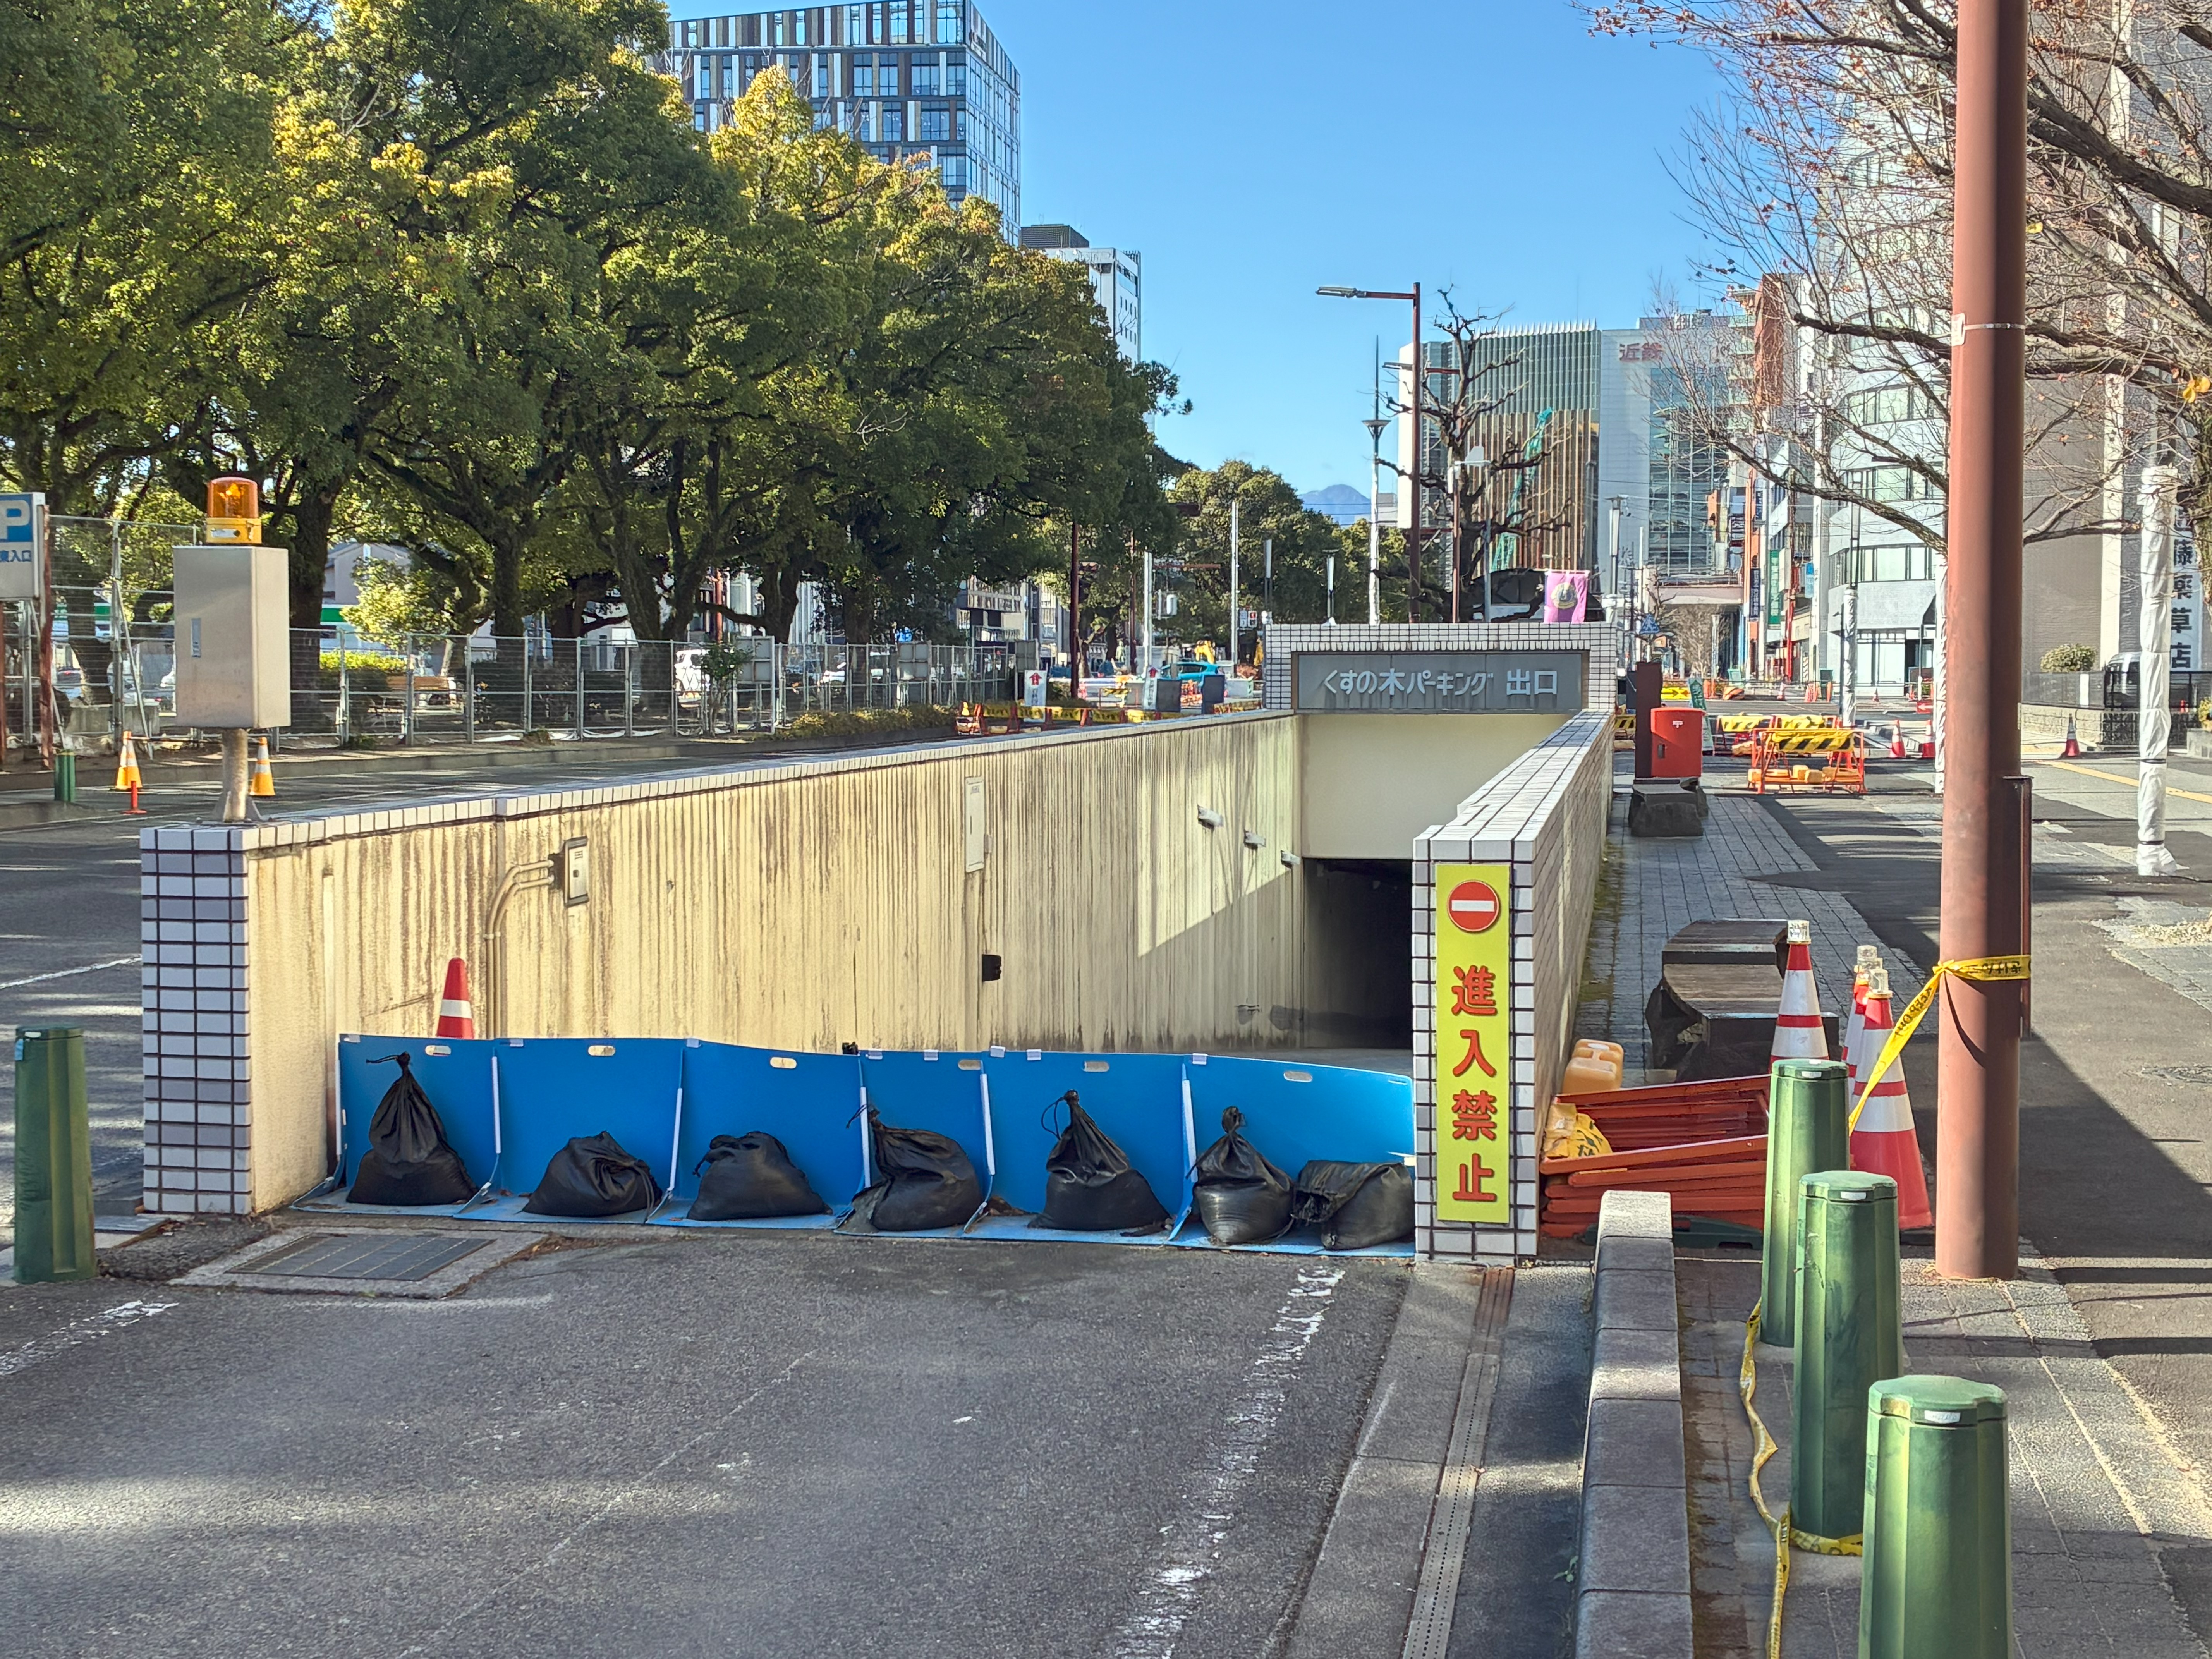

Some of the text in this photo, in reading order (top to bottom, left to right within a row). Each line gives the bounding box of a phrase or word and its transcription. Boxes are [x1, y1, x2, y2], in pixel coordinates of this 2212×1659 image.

[0, 500, 30, 539] P
[1324, 668, 1558, 696] くすの木パーキング 出口
[1451, 965, 1498, 1202] 進入禁止
